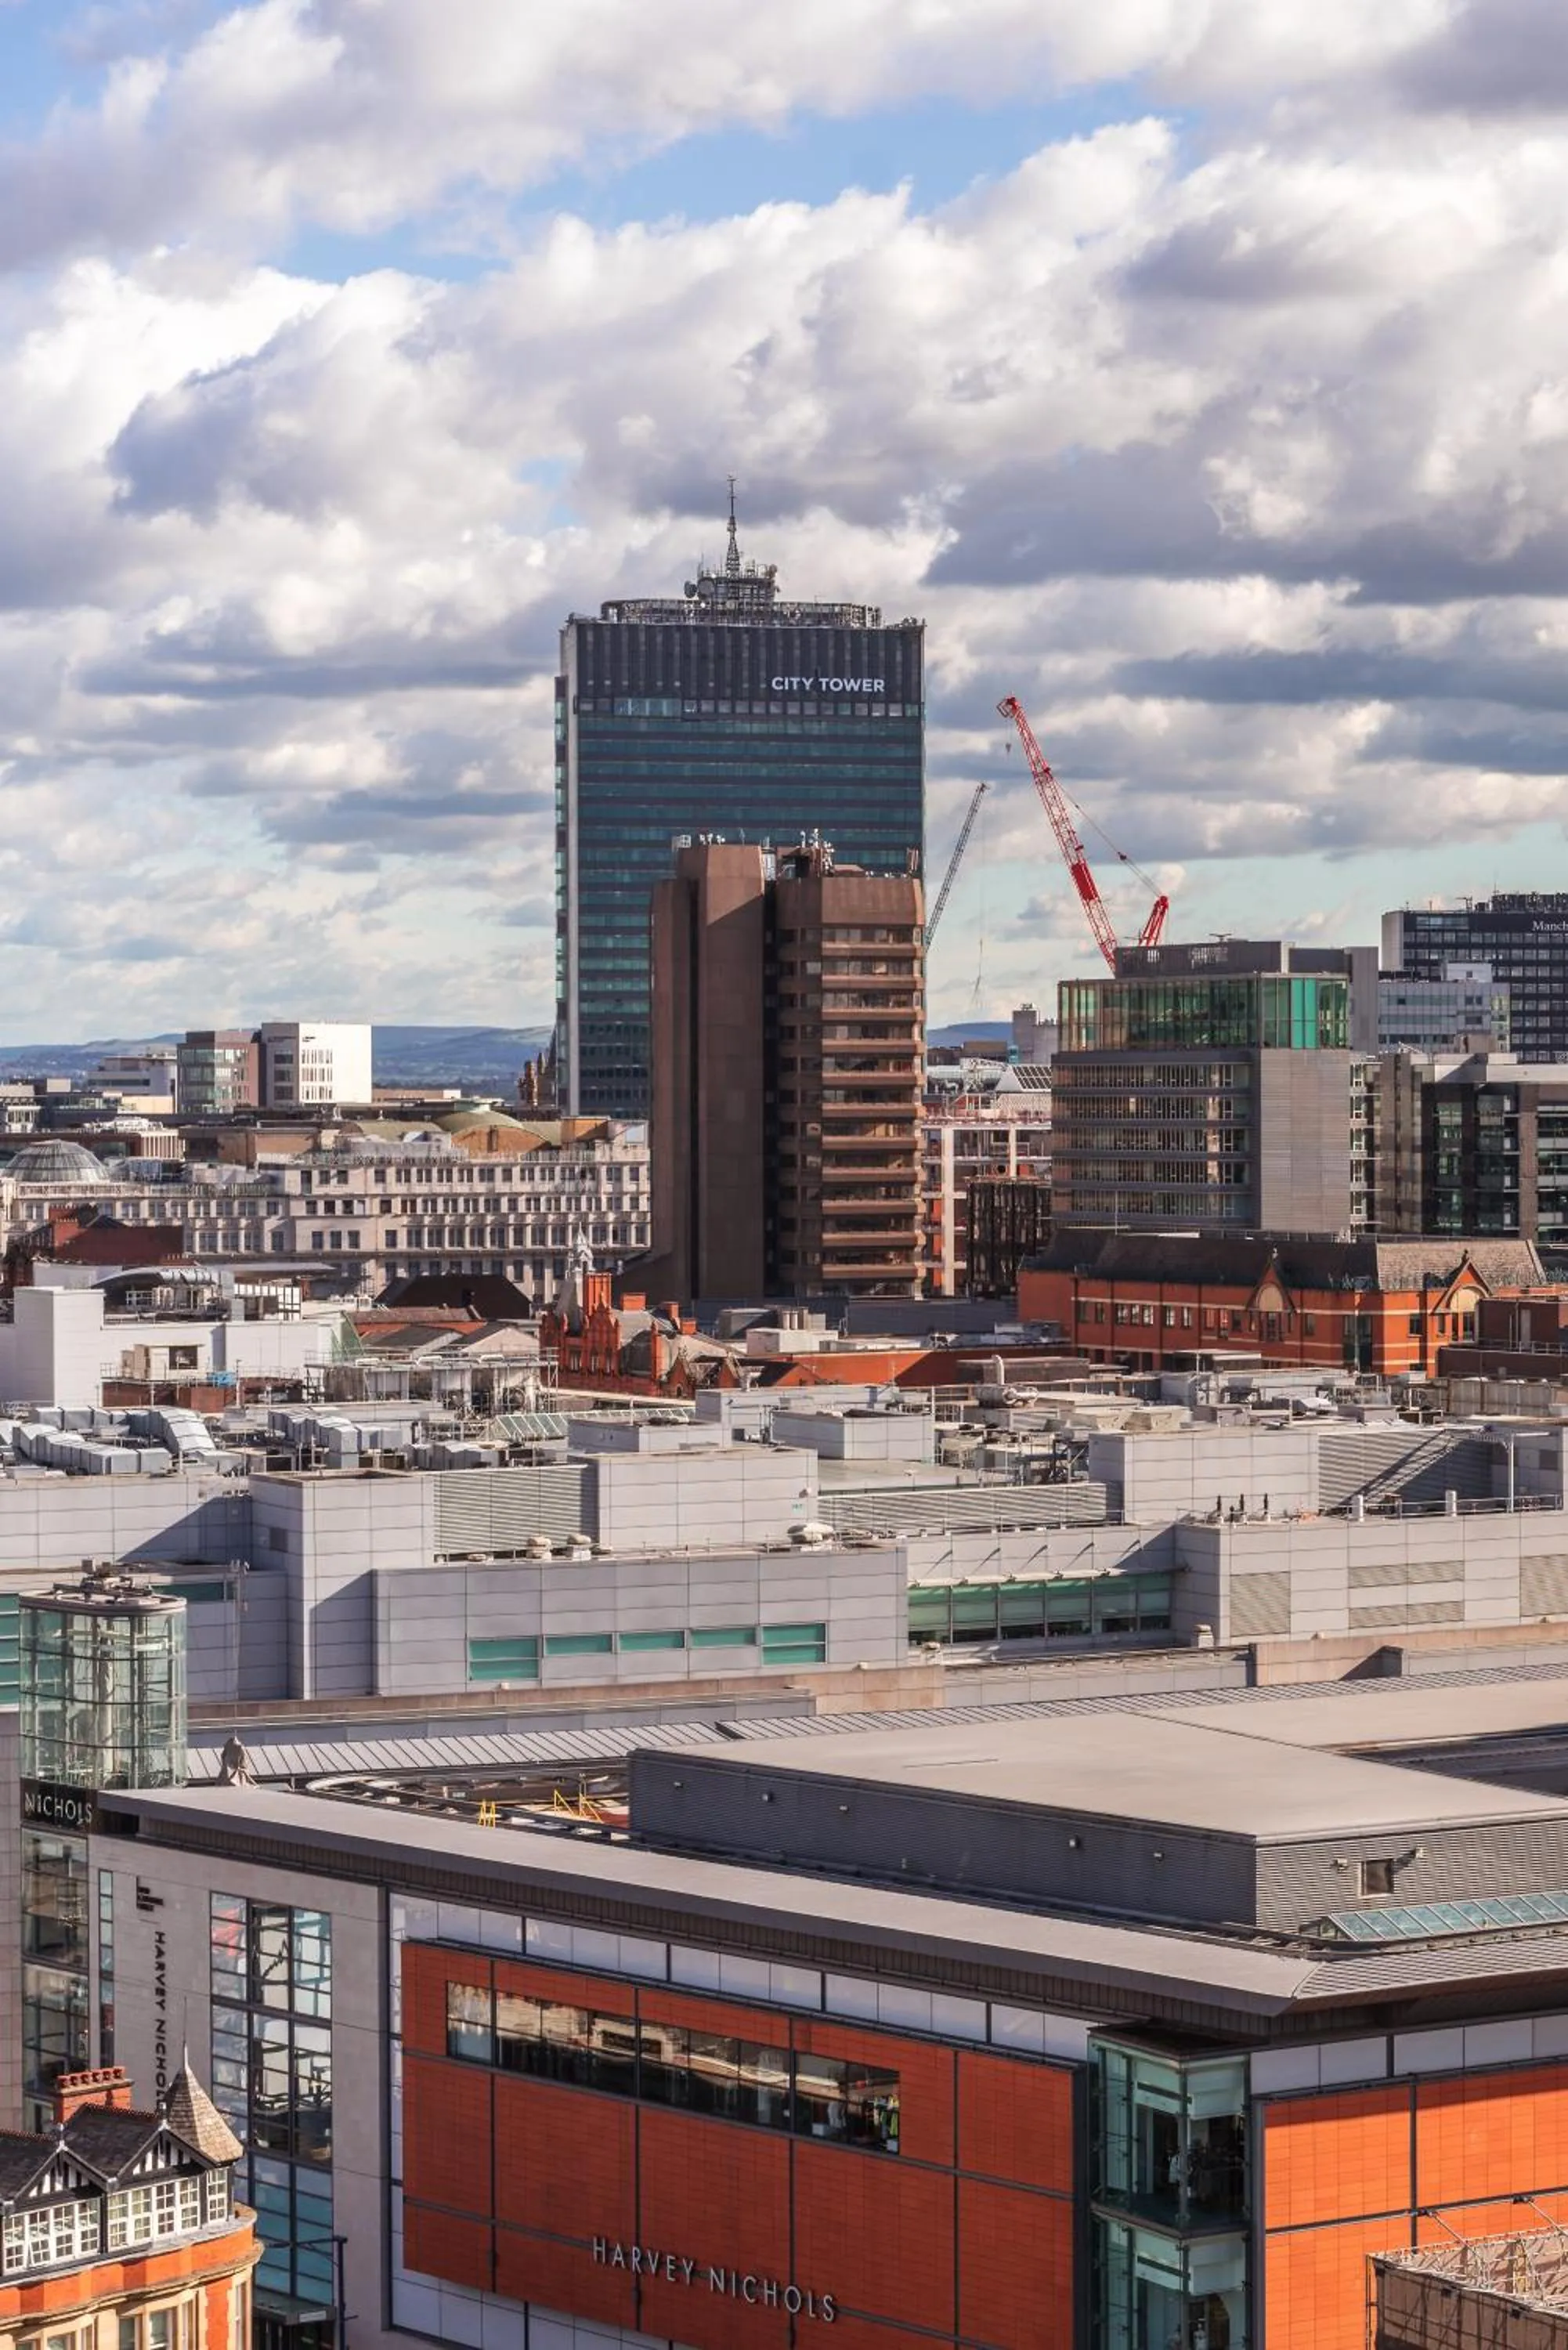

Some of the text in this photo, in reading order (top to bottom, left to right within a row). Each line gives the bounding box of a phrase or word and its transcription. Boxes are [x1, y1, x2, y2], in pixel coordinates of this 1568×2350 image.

[771, 677, 885, 692] CITY TOWER
[24, 1791, 92, 1824] NICHOLS
[154, 1931, 166, 2108] HARVEY NICHOL
[593, 2236, 835, 2322] HARVEY NICHOLS
